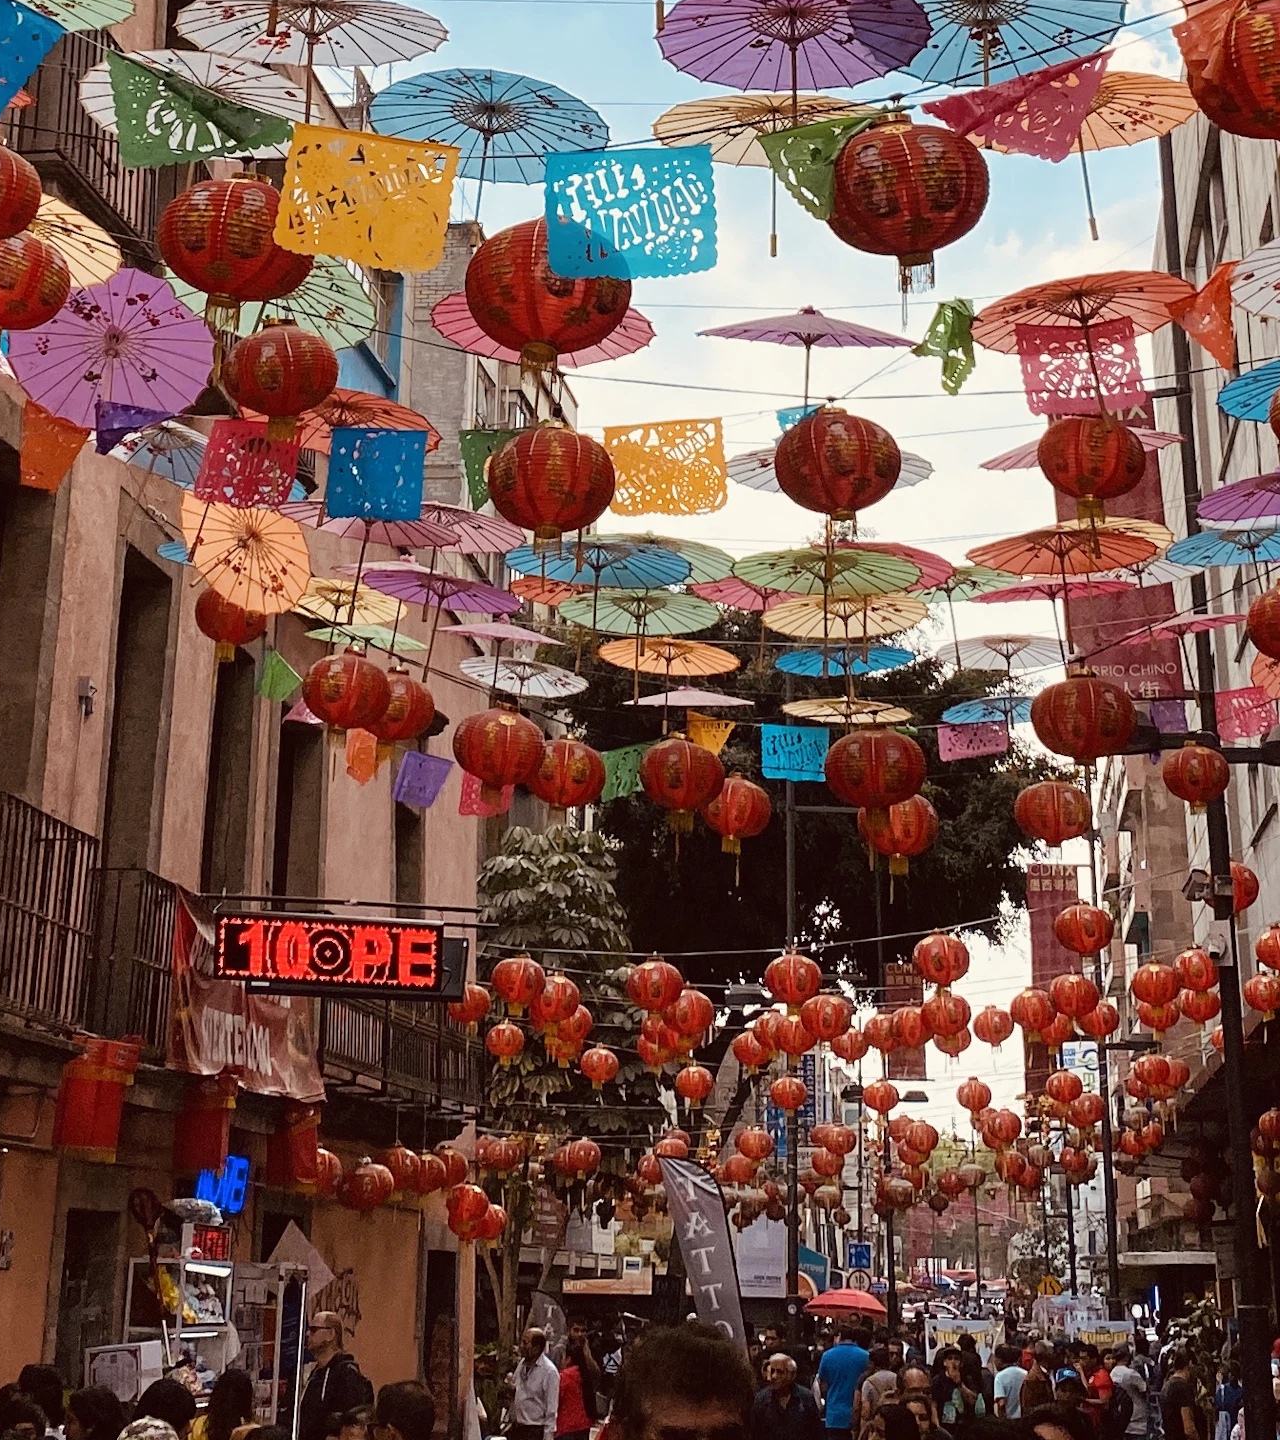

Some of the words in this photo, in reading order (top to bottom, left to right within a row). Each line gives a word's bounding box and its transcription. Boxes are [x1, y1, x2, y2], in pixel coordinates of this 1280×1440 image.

[1128, 662, 1177, 676] CHINO
[1123, 680, 1161, 699] 人街
[1029, 863, 1076, 877] CDMX
[885, 962, 917, 975] CDM
